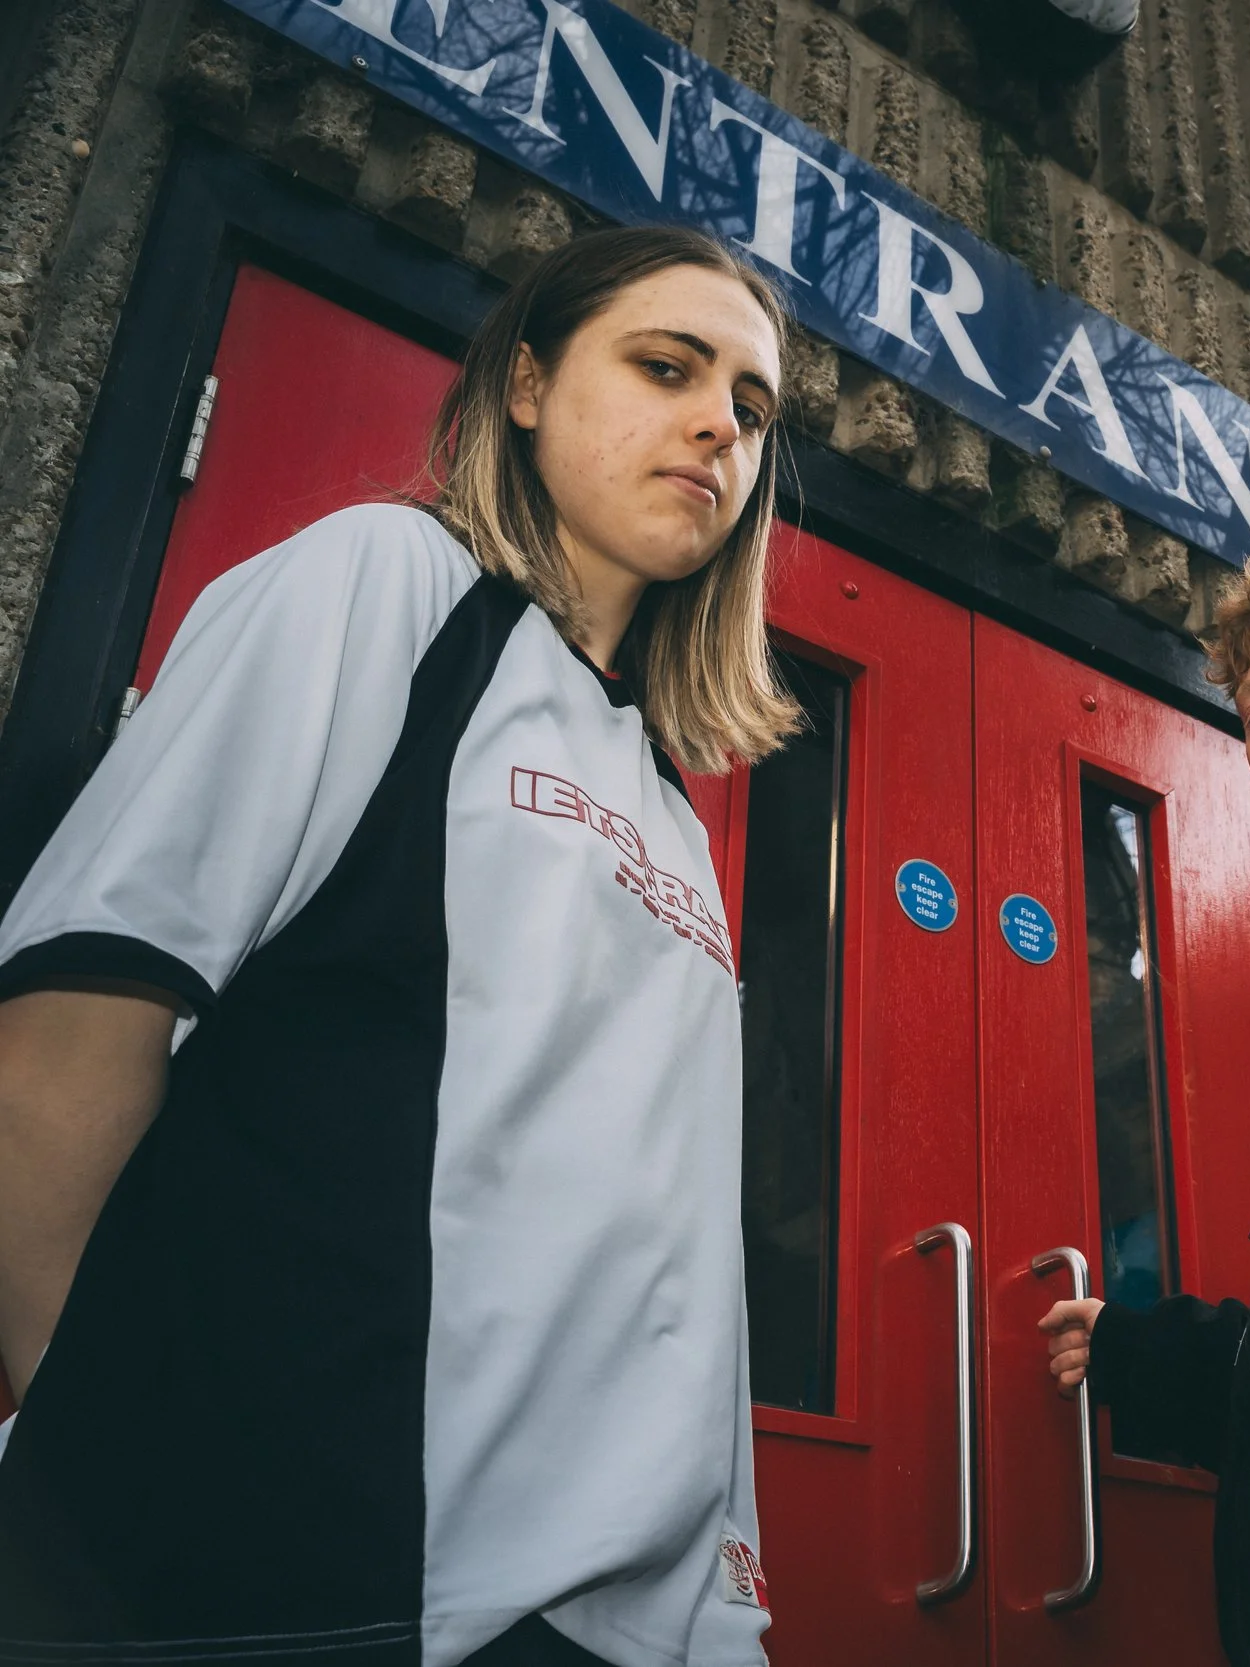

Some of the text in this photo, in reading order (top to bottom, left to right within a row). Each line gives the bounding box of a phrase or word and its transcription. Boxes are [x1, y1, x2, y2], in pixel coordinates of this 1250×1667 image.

[918, 872, 936, 887] Fire
[911, 882, 944, 900] escape
[916, 894, 938, 910] keep
[916, 906, 939, 920] clear
[1020, 907, 1037, 920] Fire
[1014, 917, 1044, 933] escape
[1019, 927, 1040, 943] keep
[1019, 939, 1041, 953] clear
